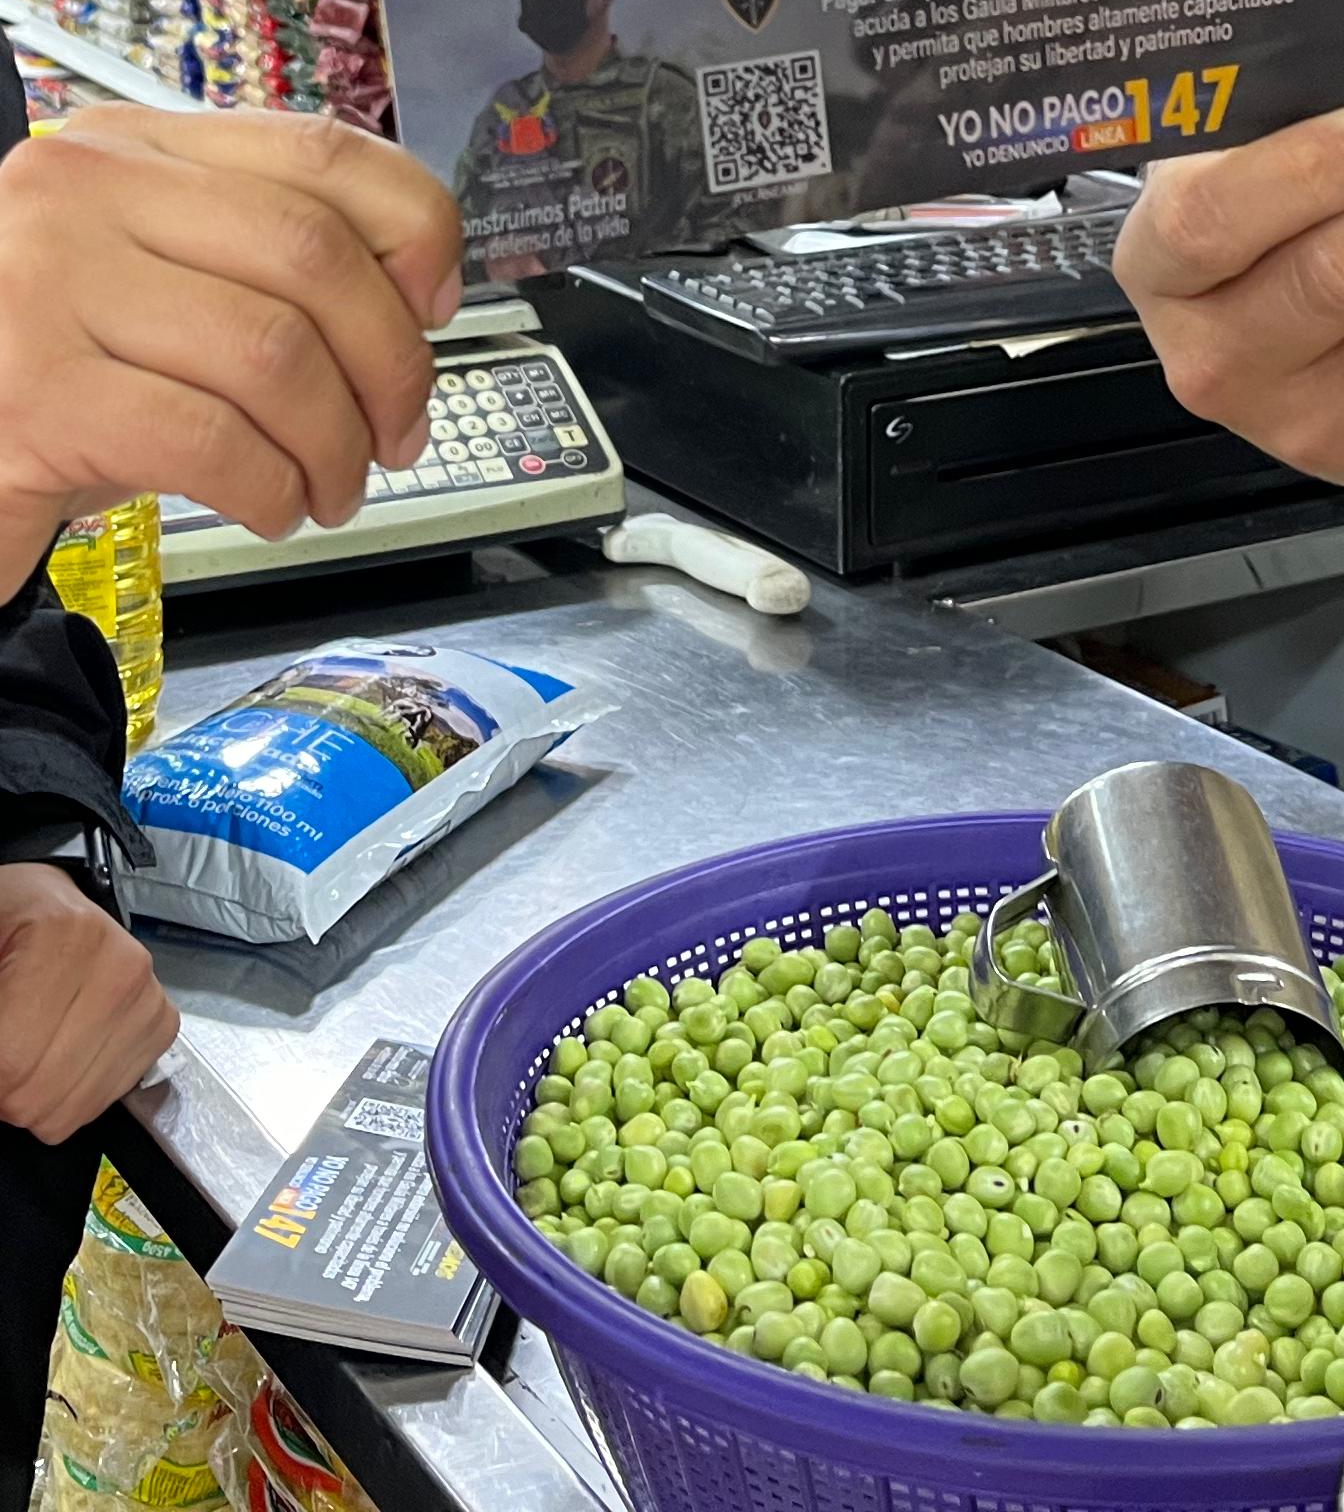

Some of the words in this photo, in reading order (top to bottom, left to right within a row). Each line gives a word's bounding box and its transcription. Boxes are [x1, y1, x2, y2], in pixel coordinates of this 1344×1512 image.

[853, 8, 911, 38] acuda
[913, 10, 928, 29] a
[930, 1, 959, 26] los
[871, 46, 886, 72] y
[889, 29, 960, 67] permita
[963, 27, 1000, 56] que
[1002, 13, 1085, 45] hombres
[939, 50, 1017, 89] protejan
[1018, 50, 1043, 72] su
[1044, 34, 1116, 67] libertad
[1118, 38, 1131, 62] y
[1133, 19, 1233, 61] patrimonio
[937, 108, 982, 147] YO
[989, 100, 1037, 140] NO
[1042, 85, 1125, 131] PAGO
[1123, 64, 1241, 144] 147
[961, 148, 986, 169] YO
[987, 134, 1070, 166] DENUNCIO
[461, 200, 565, 239] onstruimos
[567, 191, 628, 220] Patria
[486, 232, 551, 261] defensa
[554, 223, 575, 247] de
[576, 218, 593, 244] la
[595, 215, 632, 239] vida
[254, 796, 298, 824] 1100
[295, 819, 325, 843] ml
[253, 1203, 318, 1250] 147
